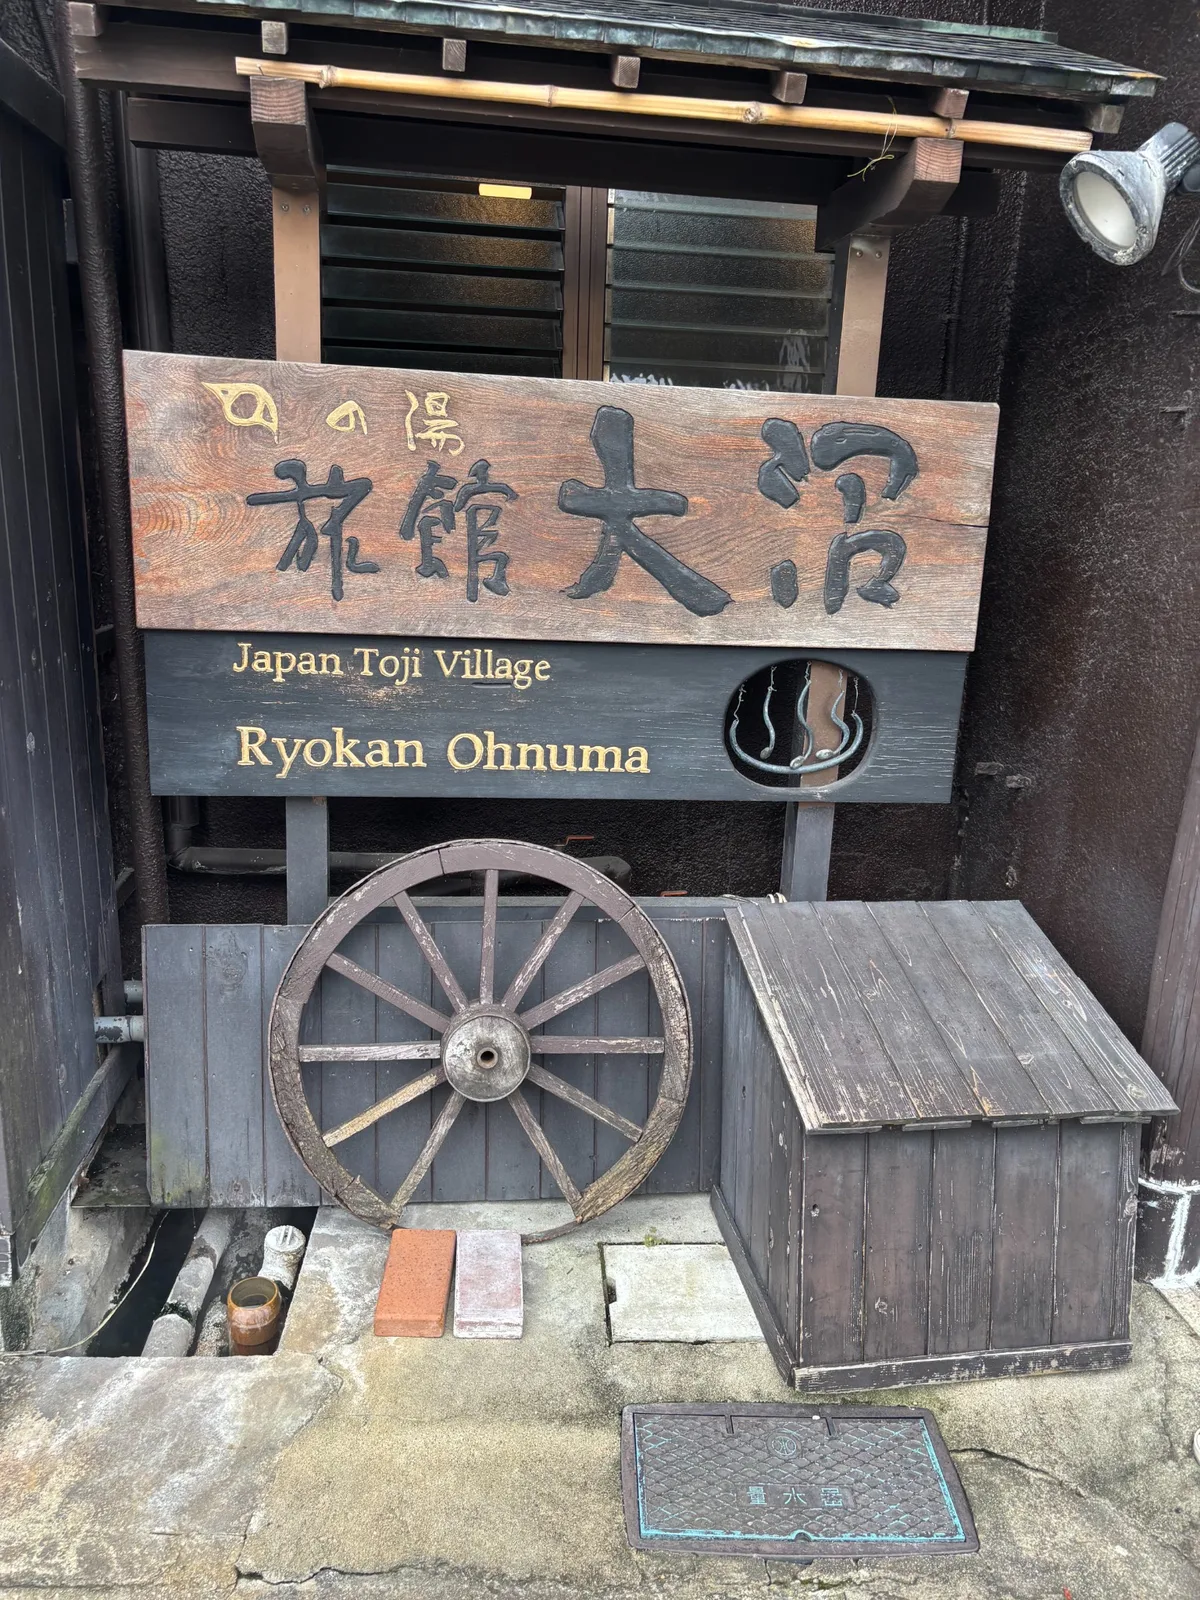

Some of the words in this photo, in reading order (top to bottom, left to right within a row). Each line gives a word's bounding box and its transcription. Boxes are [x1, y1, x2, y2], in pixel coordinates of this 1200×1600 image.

[232, 643, 342, 682] Japan
[353, 647, 423, 685] Toji
[434, 649, 551, 689] Village
[236, 726, 427, 778] Ryokan
[446, 731, 651, 774] Ohnuma
